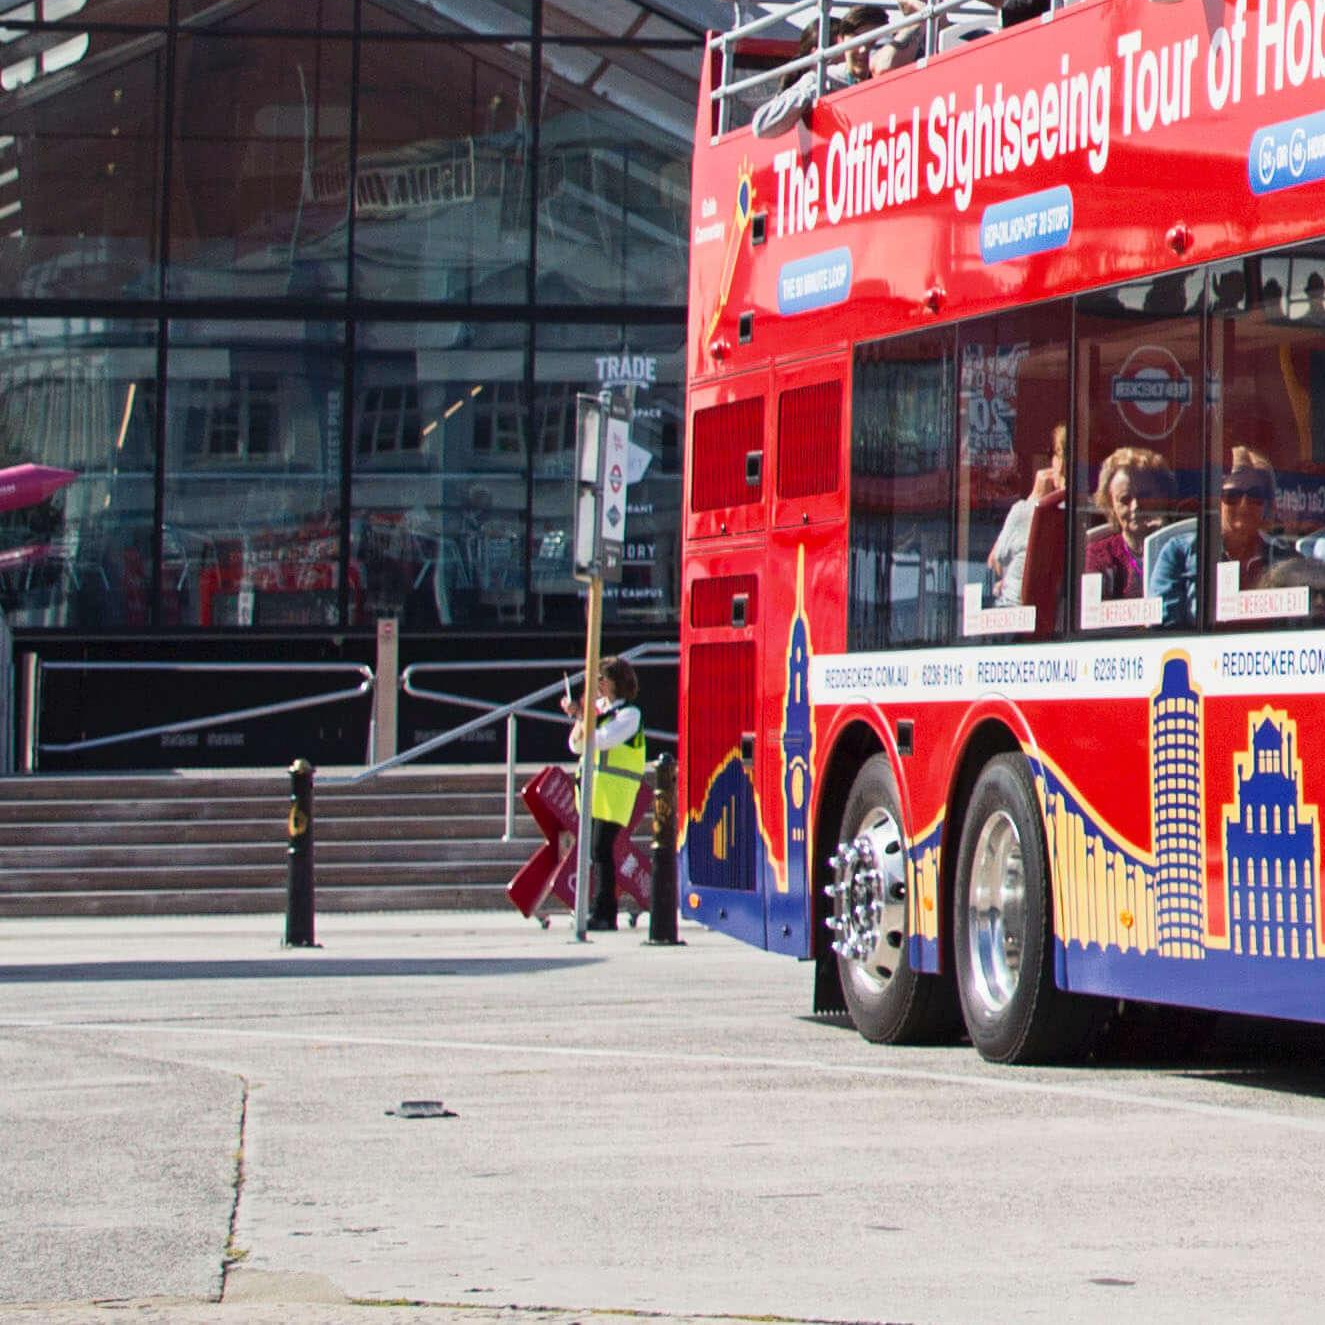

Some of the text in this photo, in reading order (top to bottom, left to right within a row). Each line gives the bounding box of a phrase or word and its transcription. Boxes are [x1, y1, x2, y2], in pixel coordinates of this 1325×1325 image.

[774, 148, 820, 238] The
[826, 106, 920, 224] Official
[926, 53, 1112, 212] Sightseeing
[1117, 30, 1199, 136] Tour
[595, 356, 656, 381] TRADE
[824, 663, 964, 690] REDDECKER.COM.AU 6236 9116
[977, 656, 1144, 685] REDDECKER.COM.AU 6236 9116
